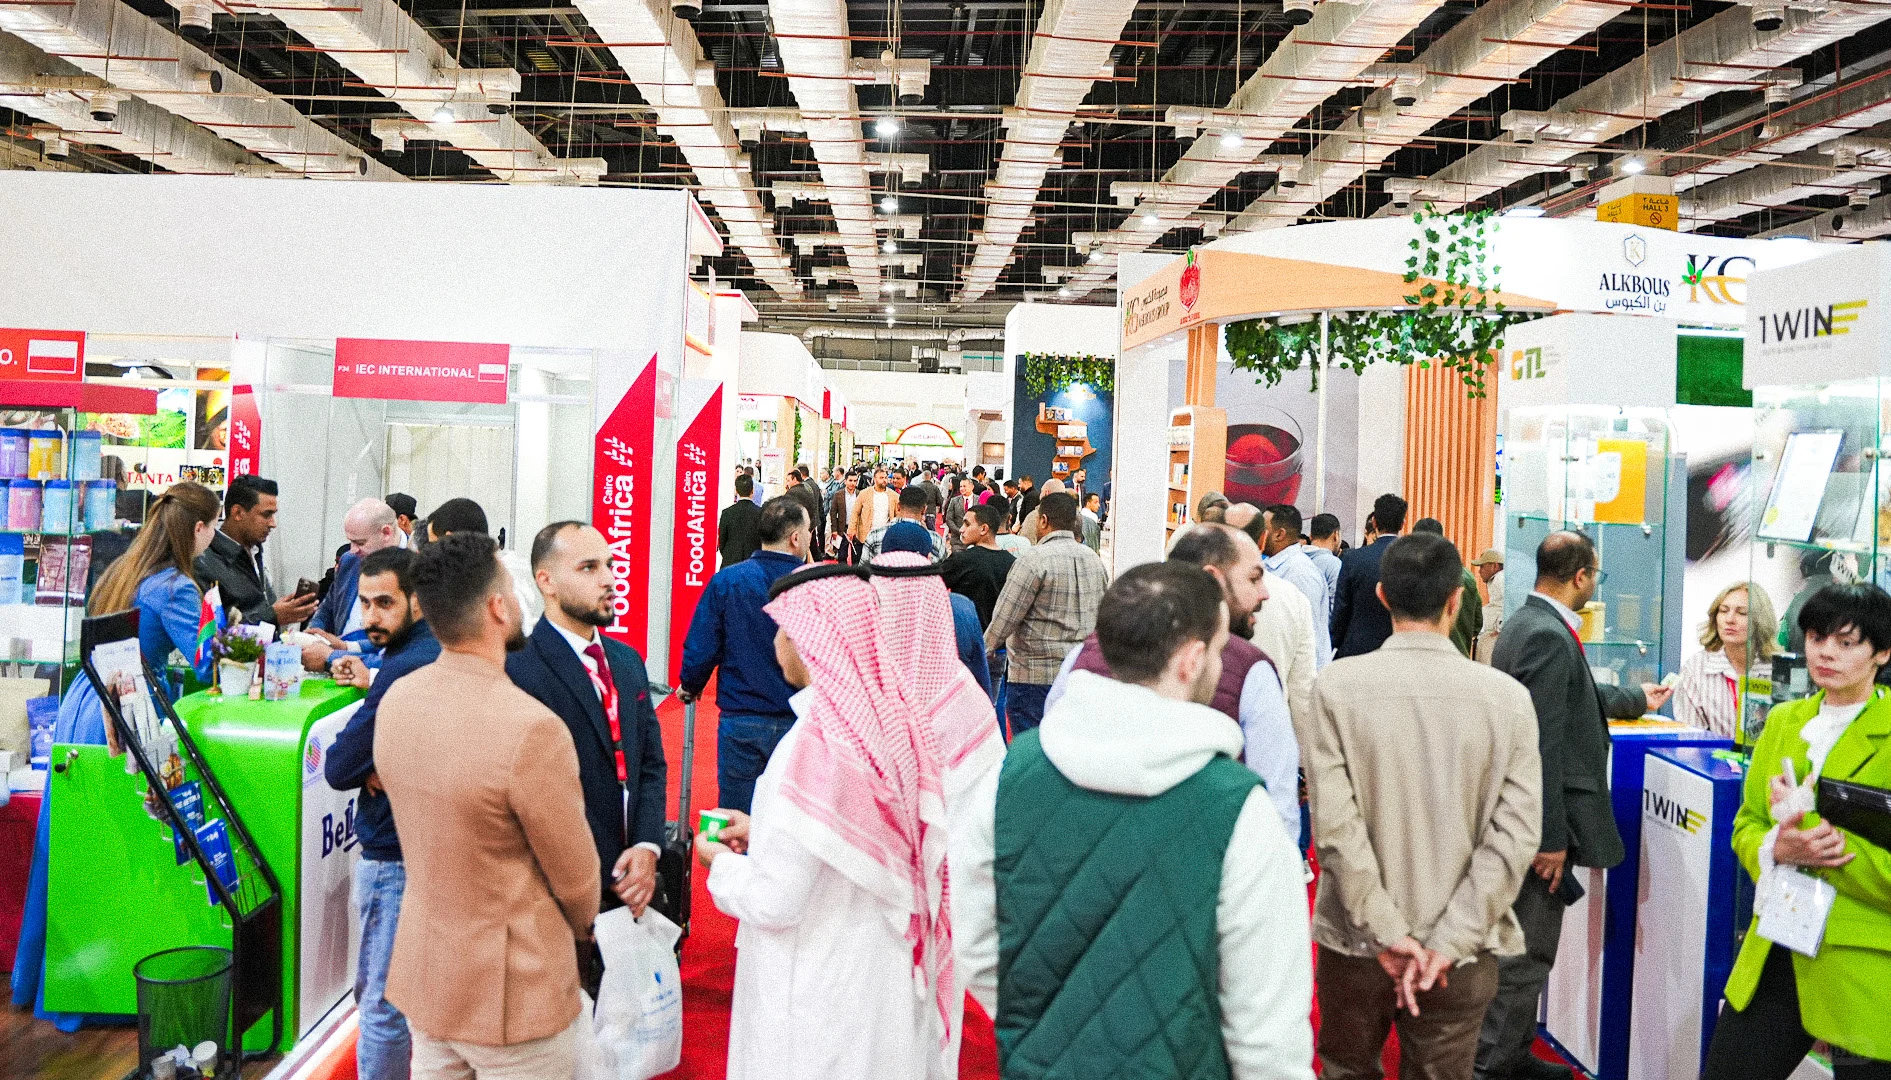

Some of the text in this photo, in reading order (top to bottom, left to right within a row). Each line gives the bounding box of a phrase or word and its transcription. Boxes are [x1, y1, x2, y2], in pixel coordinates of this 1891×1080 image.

[1643, 204, 1662, 212] HALL
[1599, 272, 1671, 298] ALKBOUS
[1605, 295, 1650, 311] الكبوس
[355, 363, 376, 375] IEC
[378, 364, 475, 379] INTERNATIONAL
[126, 471, 173, 485] TANTA
[603, 474, 613, 505] Cairo
[683, 470, 692, 493] Cairo
[685, 470, 707, 586] FoodAfrica
[604, 474, 634, 633] FoodAfrica
